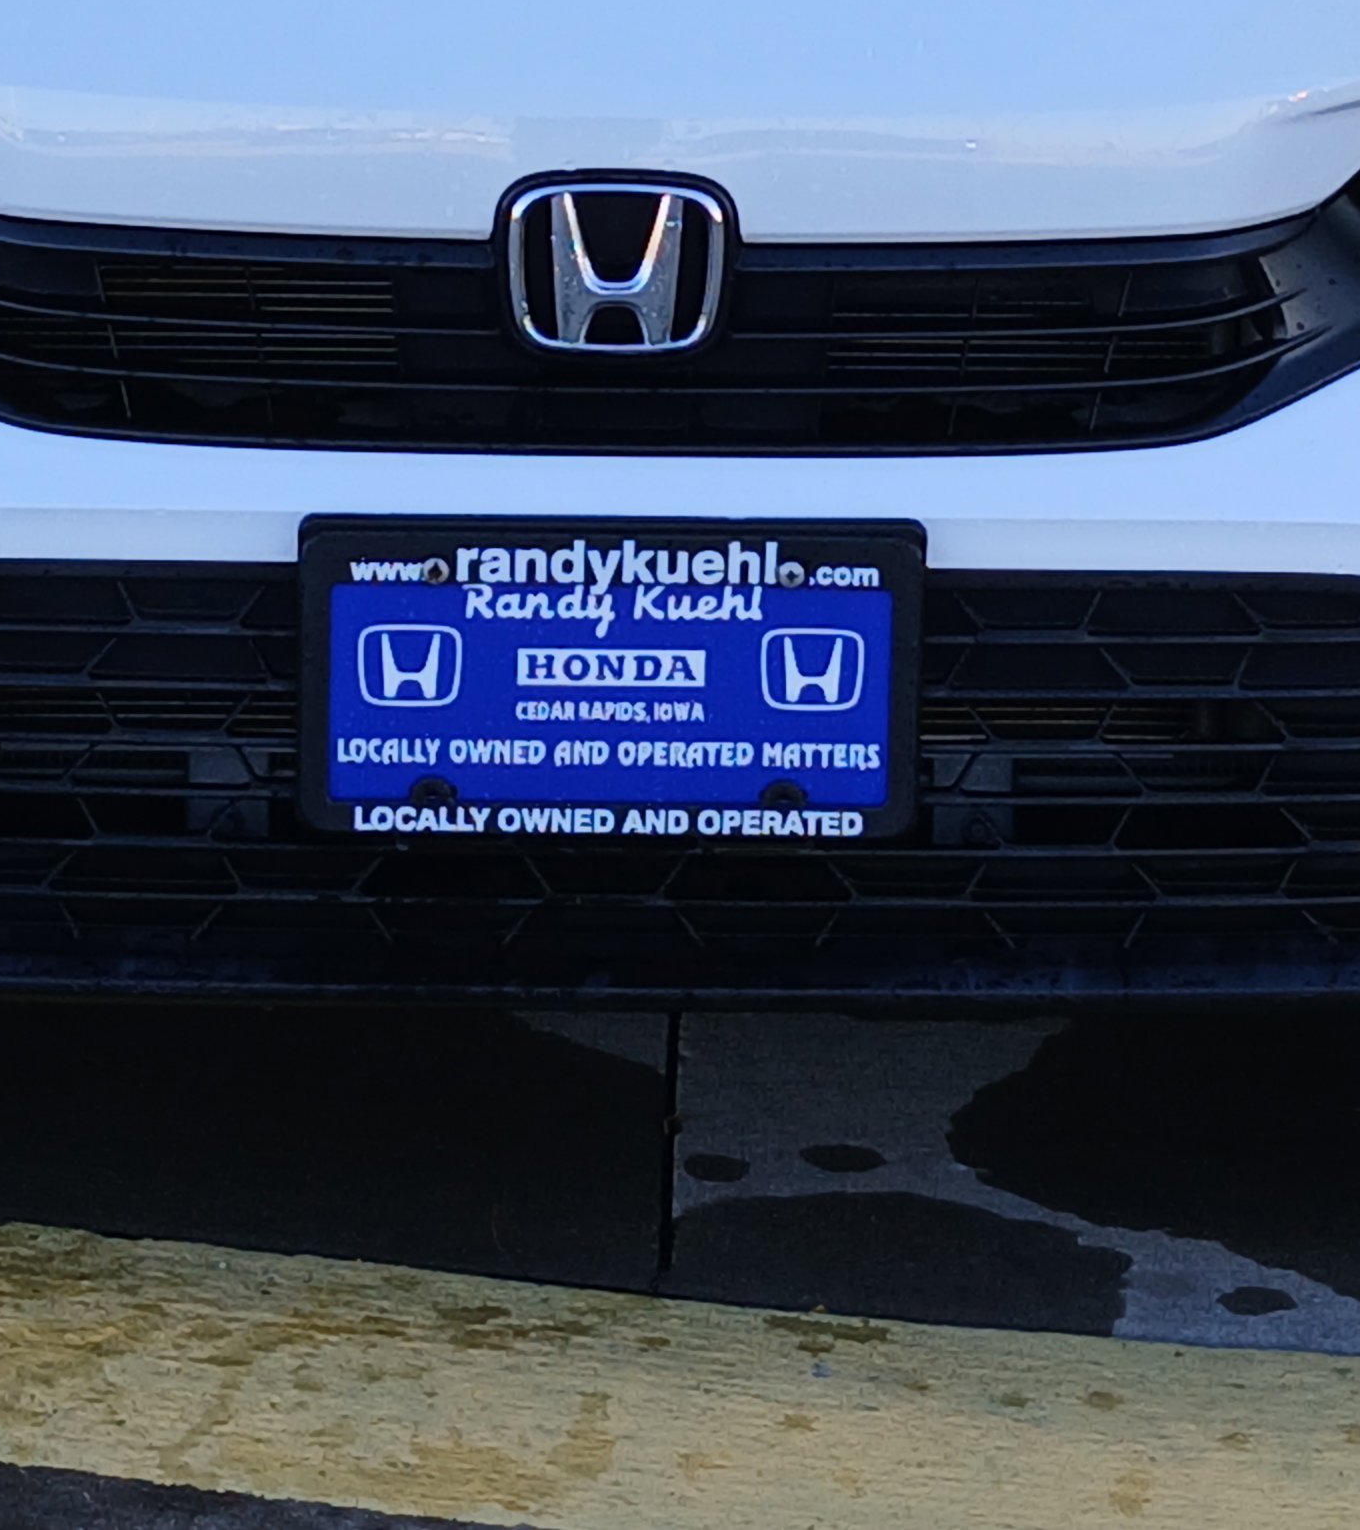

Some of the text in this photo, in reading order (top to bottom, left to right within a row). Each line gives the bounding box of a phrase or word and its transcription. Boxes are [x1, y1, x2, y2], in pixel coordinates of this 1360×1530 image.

[455, 539, 778, 595] randykuehl
[462, 583, 763, 639] Randy Kuehl
[526, 653, 697, 682] HONDA
[516, 701, 705, 724] CEDAR RAPIDS, IOWA
[337, 738, 880, 770] LOCALLY OWNED AND OPERATED MATTERS
[354, 806, 863, 837] LOCALLY OWNED AND OPERATED
